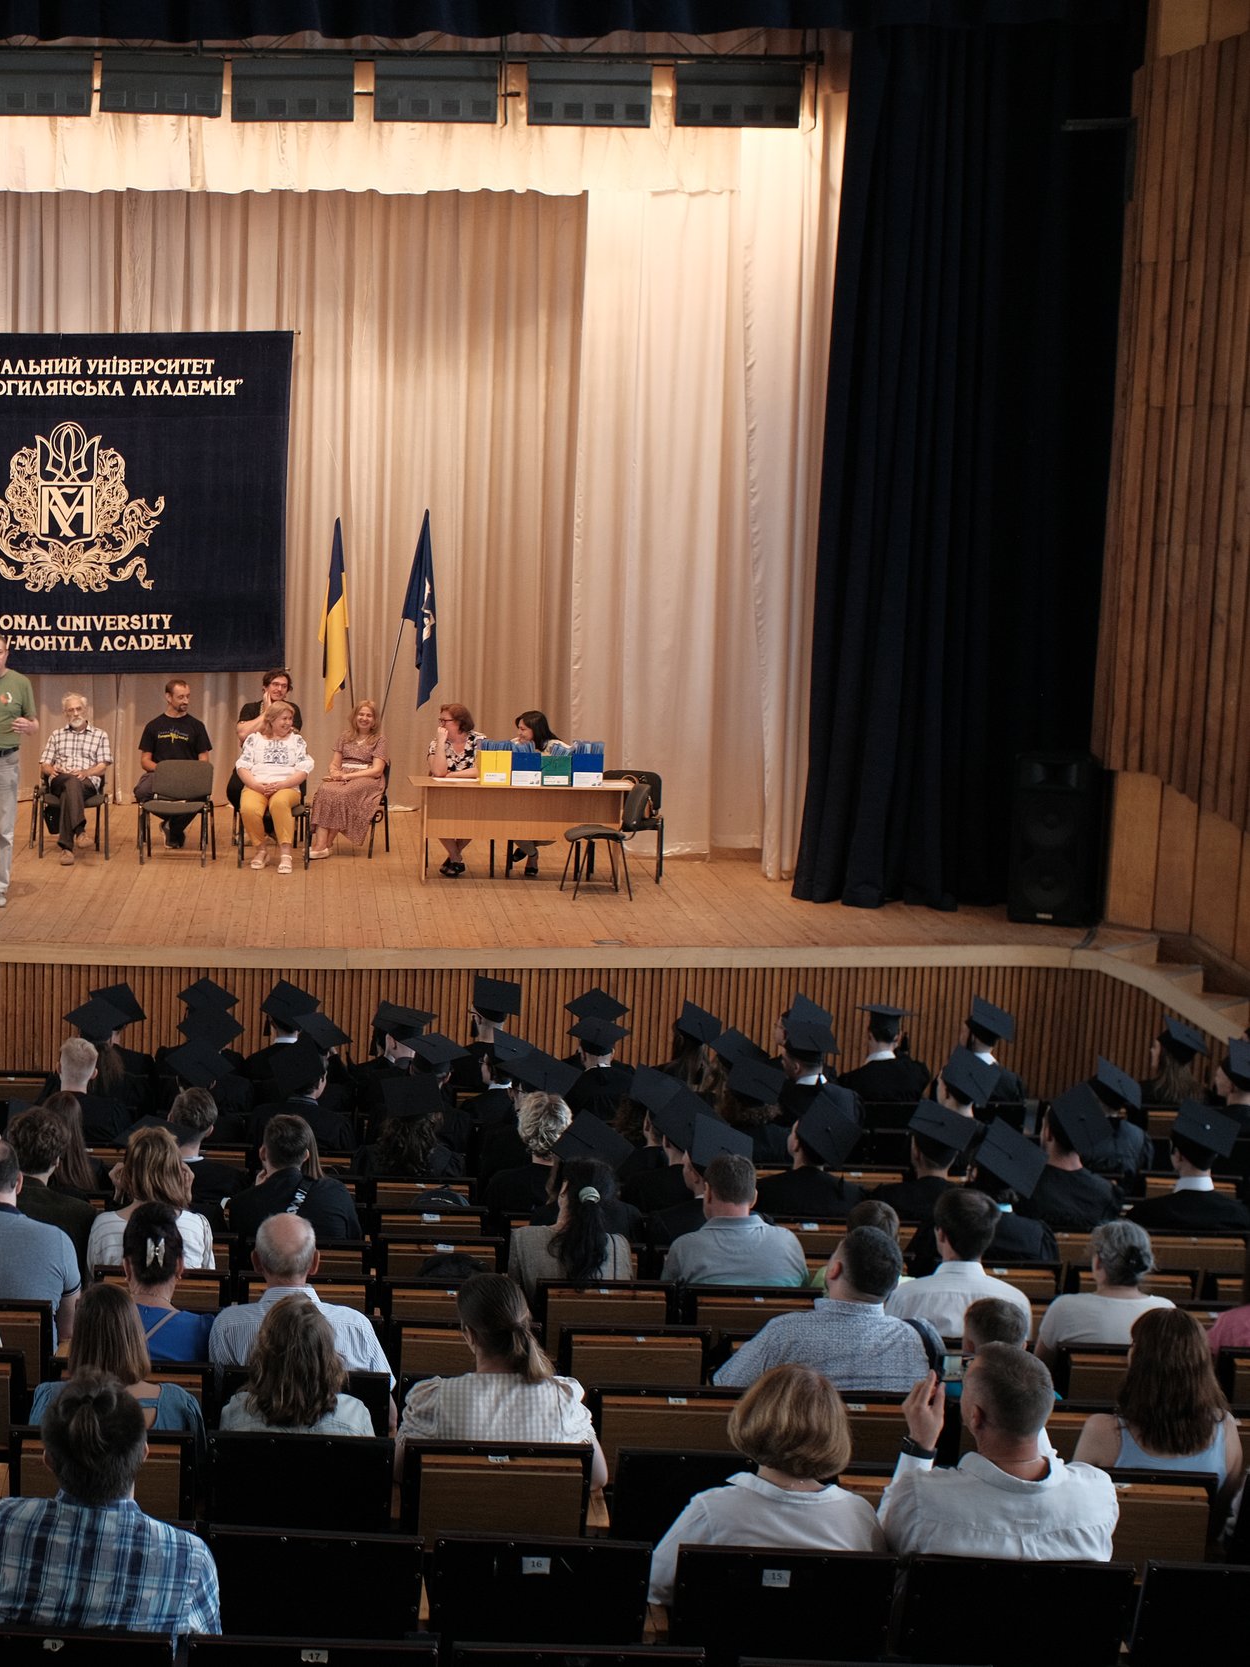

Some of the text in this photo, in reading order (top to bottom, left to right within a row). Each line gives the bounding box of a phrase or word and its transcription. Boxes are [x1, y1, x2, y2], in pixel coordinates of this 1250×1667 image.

[86, 356, 215, 376] УНІВЕРСИТЕТ
[56, 613, 173, 632] UNIVERSITY
[99, 634, 194, 652] ACADEMY
[531, 1560, 542, 1568] 16
[771, 1572, 783, 1580] 15
[309, 1652, 321, 1660] 17
